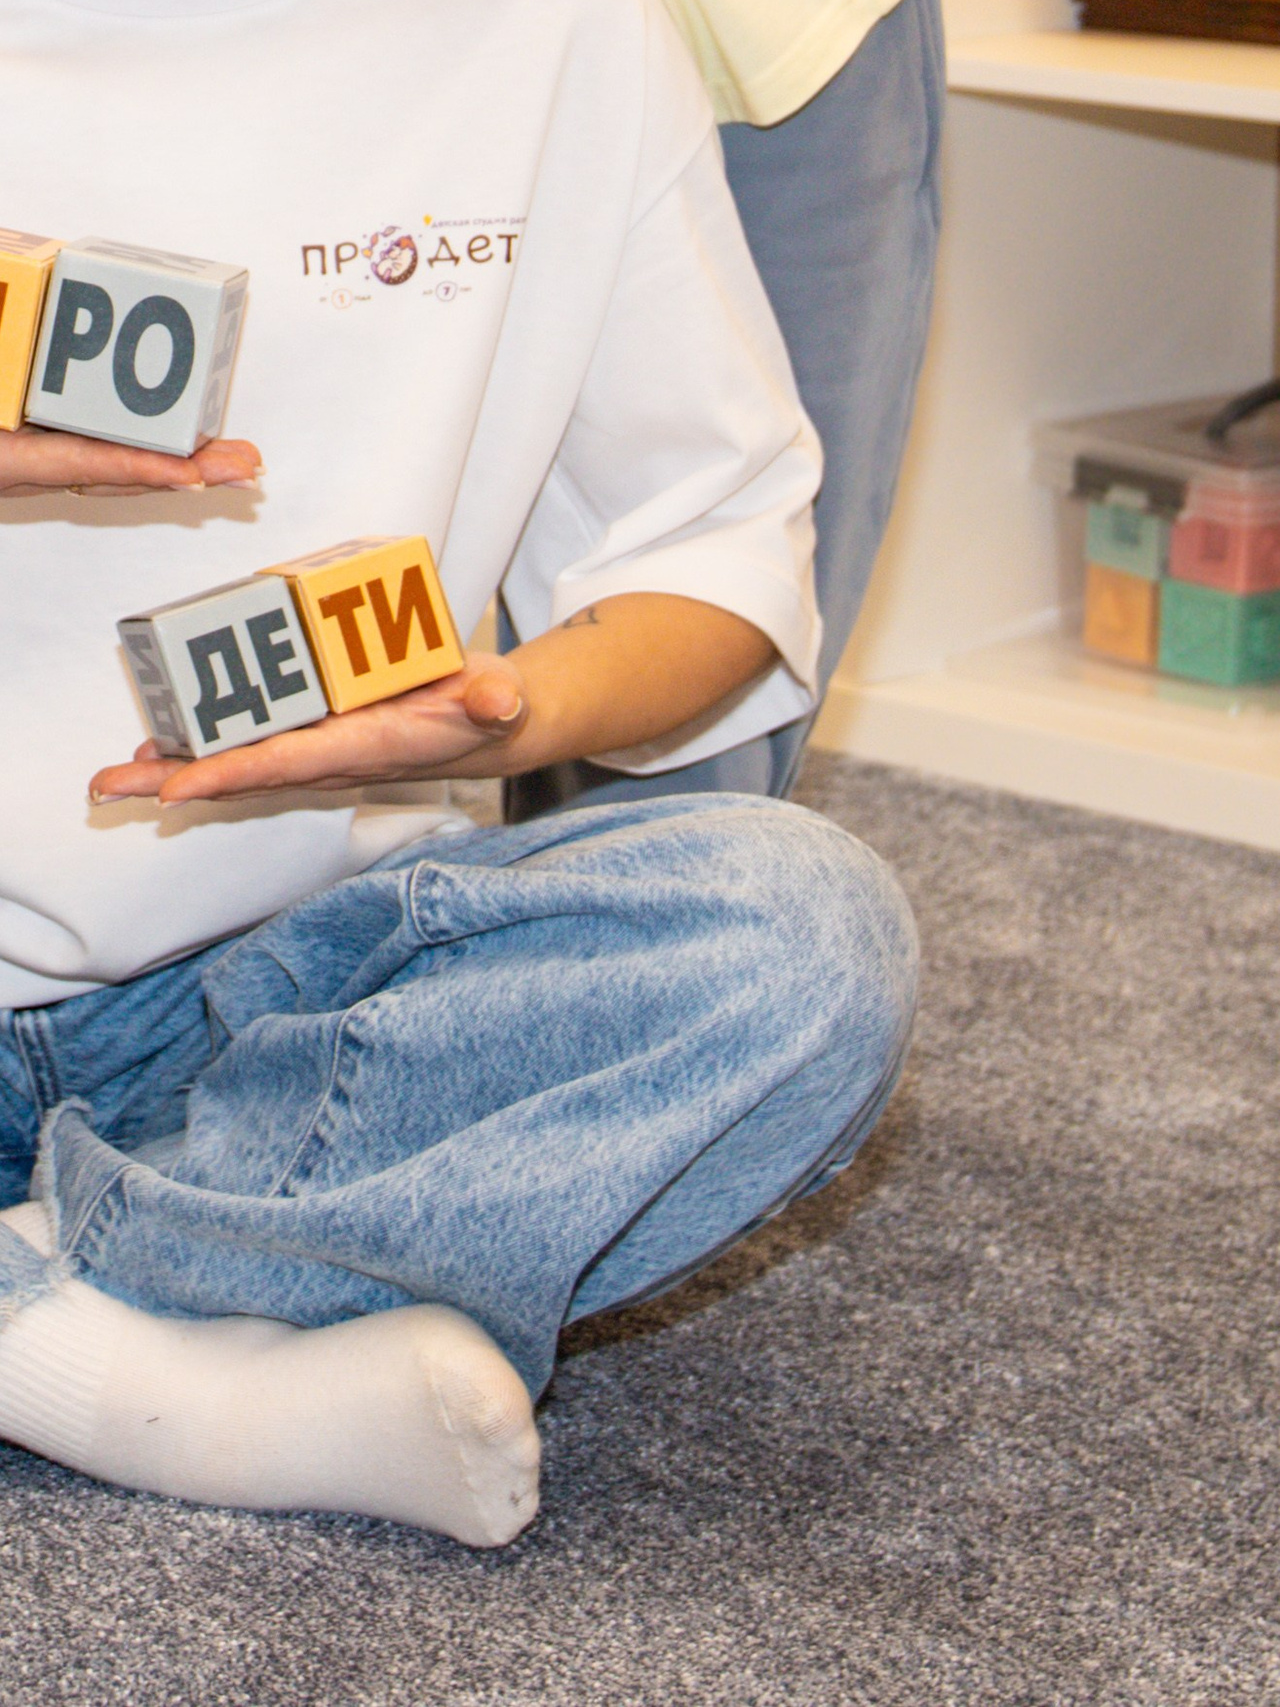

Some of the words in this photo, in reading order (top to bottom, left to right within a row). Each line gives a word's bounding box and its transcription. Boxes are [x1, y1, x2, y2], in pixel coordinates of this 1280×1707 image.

[41, 277, 196, 417] РО
[185, 607, 309, 744] ДЕ
[316, 563, 445, 678] ТИ
